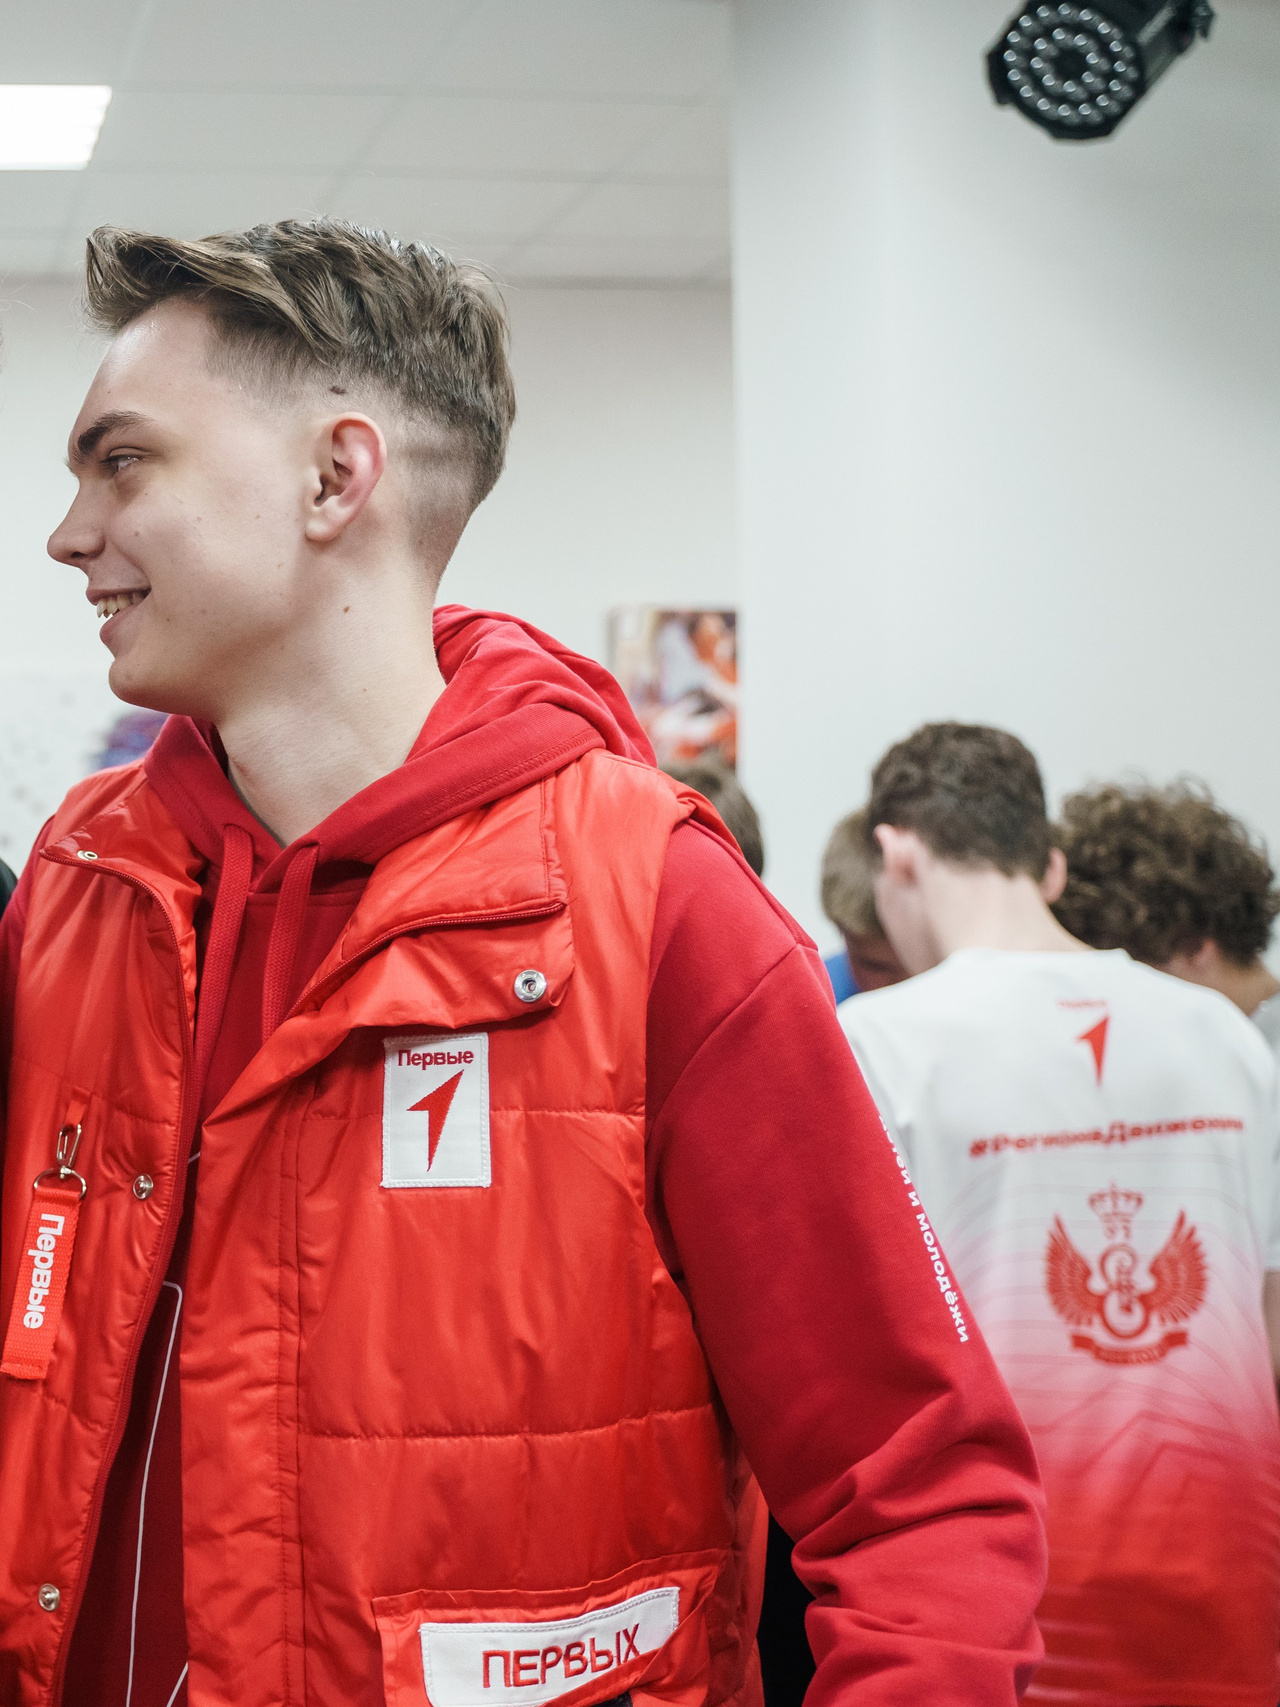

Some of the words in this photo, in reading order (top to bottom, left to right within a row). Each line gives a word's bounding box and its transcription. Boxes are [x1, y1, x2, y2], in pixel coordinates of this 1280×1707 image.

[398, 1049, 474, 1070] Первые
[23, 1213, 65, 1329] Первые
[916, 1213, 969, 1343] молодёжи
[482, 1623, 640, 1688] ПЕРВЫХ
